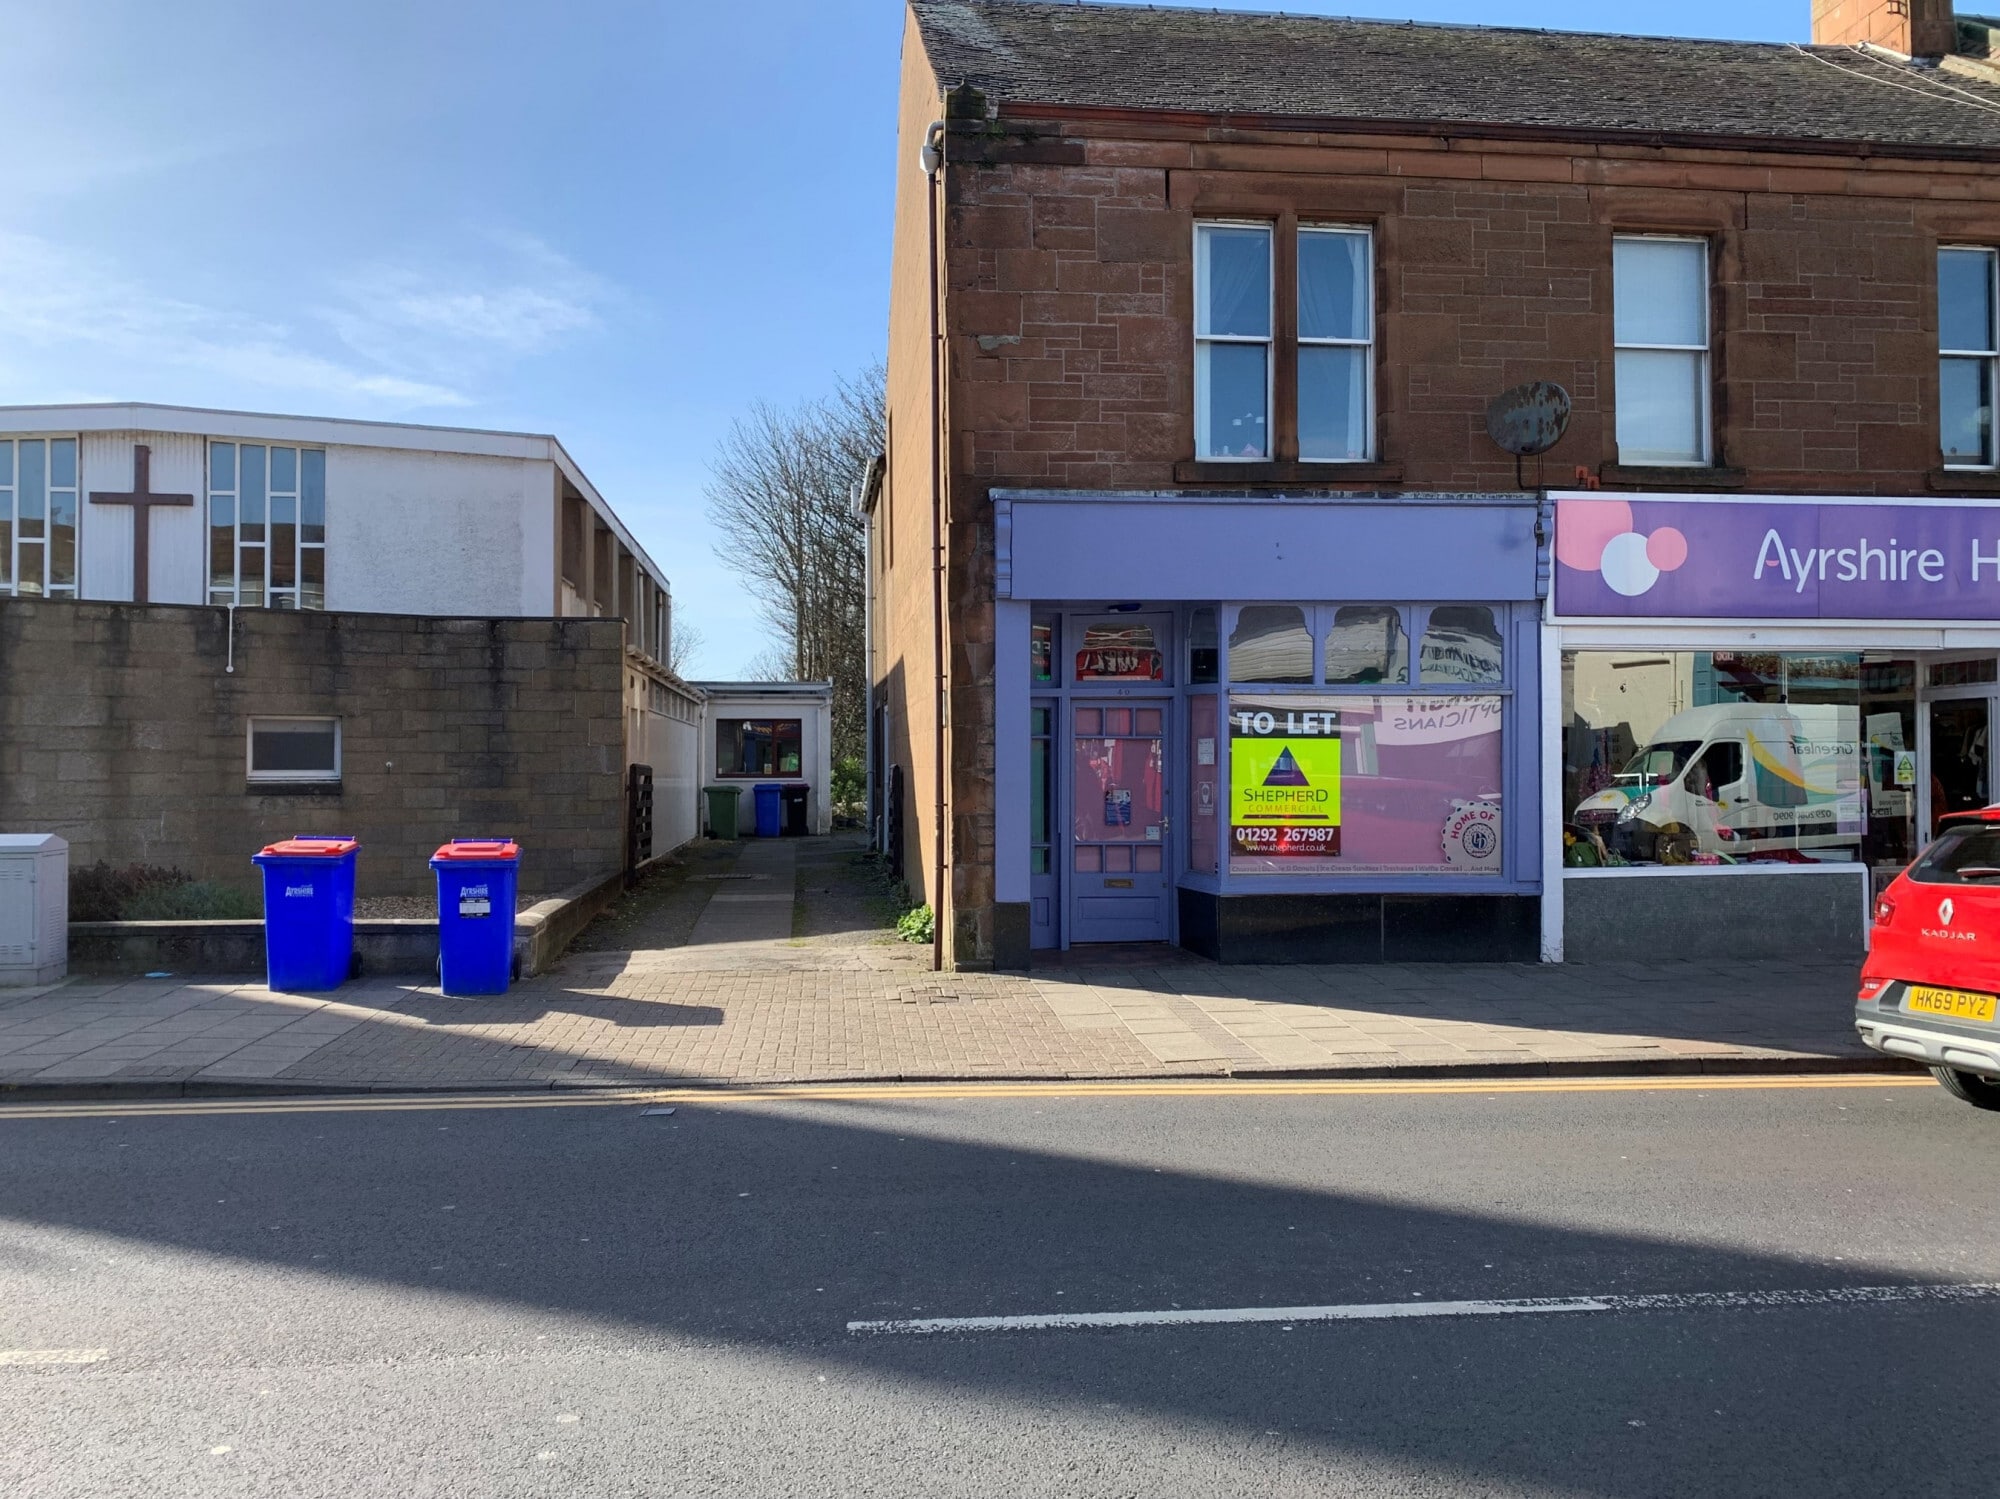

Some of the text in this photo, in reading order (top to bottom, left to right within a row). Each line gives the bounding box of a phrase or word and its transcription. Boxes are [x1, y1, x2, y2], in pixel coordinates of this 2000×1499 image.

[1753, 528, 1944, 593] Ayrshire
[1237, 711, 1336, 734] TO LET
[1243, 788, 1328, 802] SHEPHERD
[1248, 804, 1323, 813] COMMERCIAL
[1450, 810, 1496, 839] HOME OF
[1236, 828, 1334, 841] 01292 267987
[1245, 843, 1327, 853] www.shepherd.co.uk
[1921, 928, 1977, 941] KADJAR
[1915, 989, 1989, 1016] HK69 PYZ
